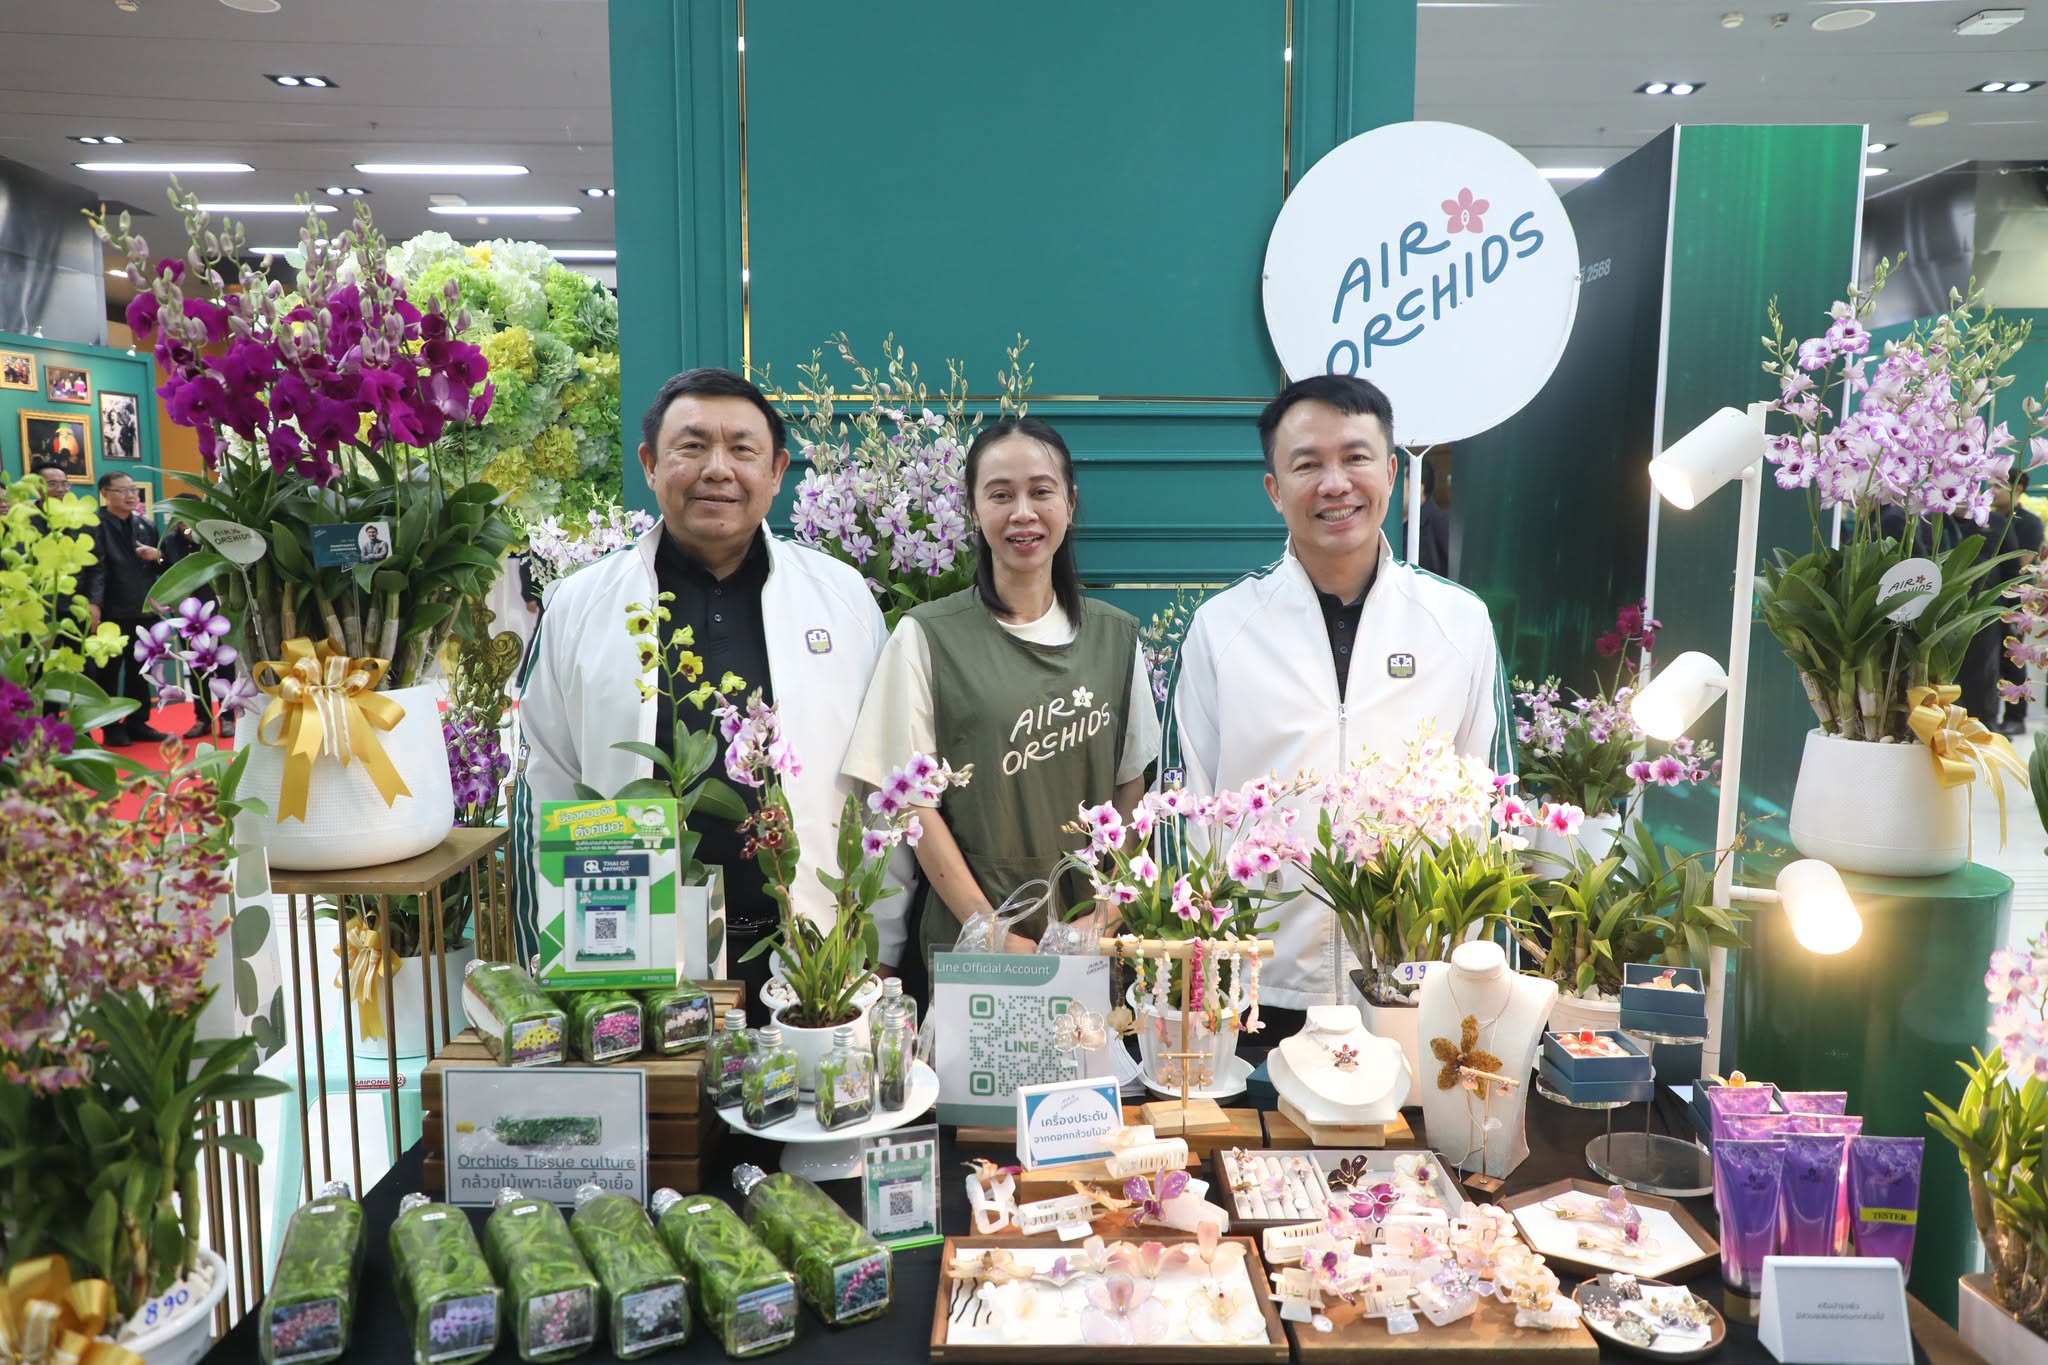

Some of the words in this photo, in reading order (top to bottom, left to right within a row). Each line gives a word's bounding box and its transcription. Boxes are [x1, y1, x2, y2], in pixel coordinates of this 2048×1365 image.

[1332, 220, 1451, 323] AIR
[1325, 211, 1544, 376] ORCHIDS
[1888, 578, 1916, 593] AIR
[1009, 697, 1076, 743] AIR
[1002, 702, 1110, 776] ORCHIDS
[936, 962, 959, 973] Line
[962, 962, 1001, 974] Official
[1004, 963, 1050, 975] Account
[1004, 1040, 1038, 1053] LINE
[1041, 1110, 1108, 1127] เครื่องประดับ
[458, 1155, 519, 1168] Orchids
[524, 1155, 575, 1168] Tissue
[581, 1157, 636, 1169] culture
[1872, 1211, 1907, 1221] TESTER
[144, 1289, 189, 1325] 890
